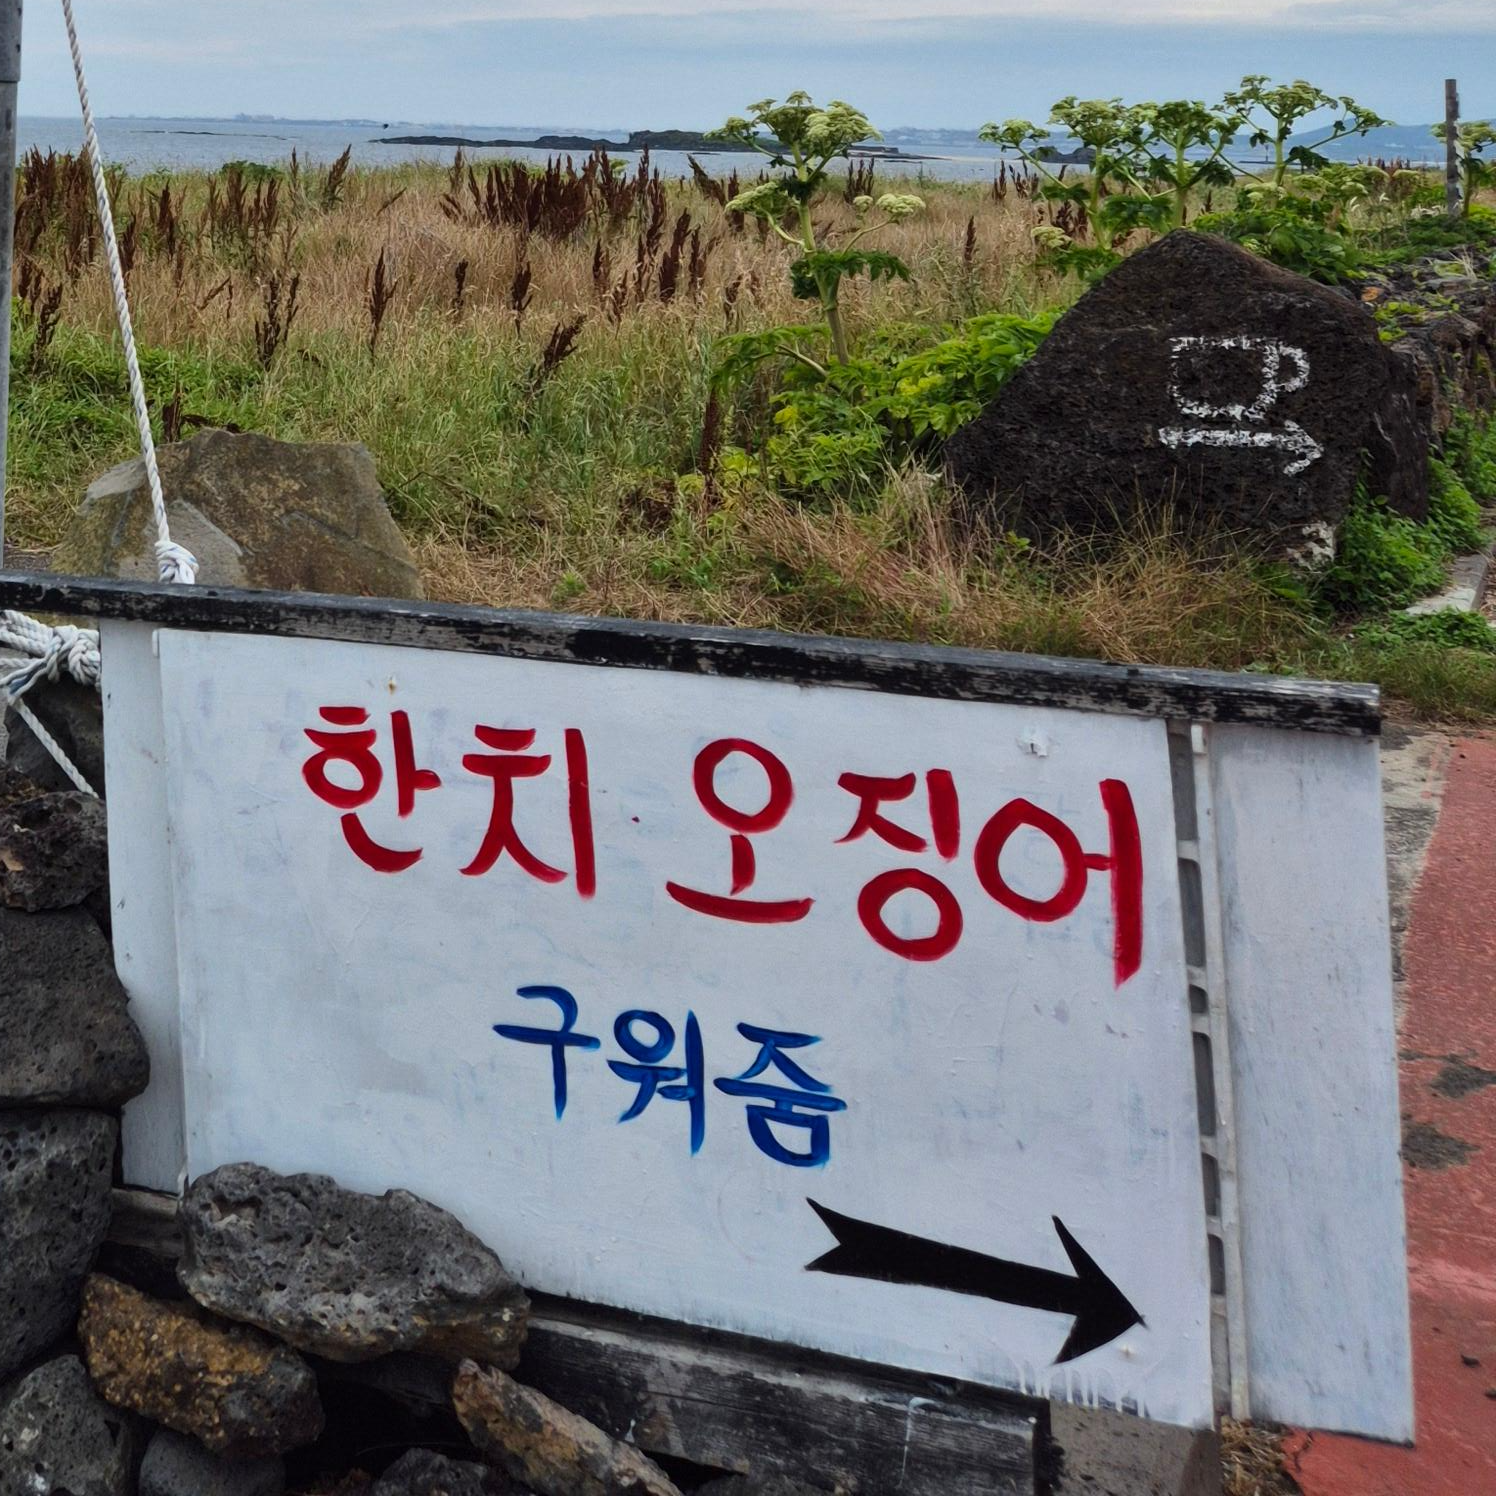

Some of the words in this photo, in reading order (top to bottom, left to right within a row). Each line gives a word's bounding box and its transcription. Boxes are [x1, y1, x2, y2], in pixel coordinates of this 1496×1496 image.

[302, 706, 596, 899] 한치
[666, 737, 1144, 986] 오징어
[493, 986, 848, 1168] 구워줌
